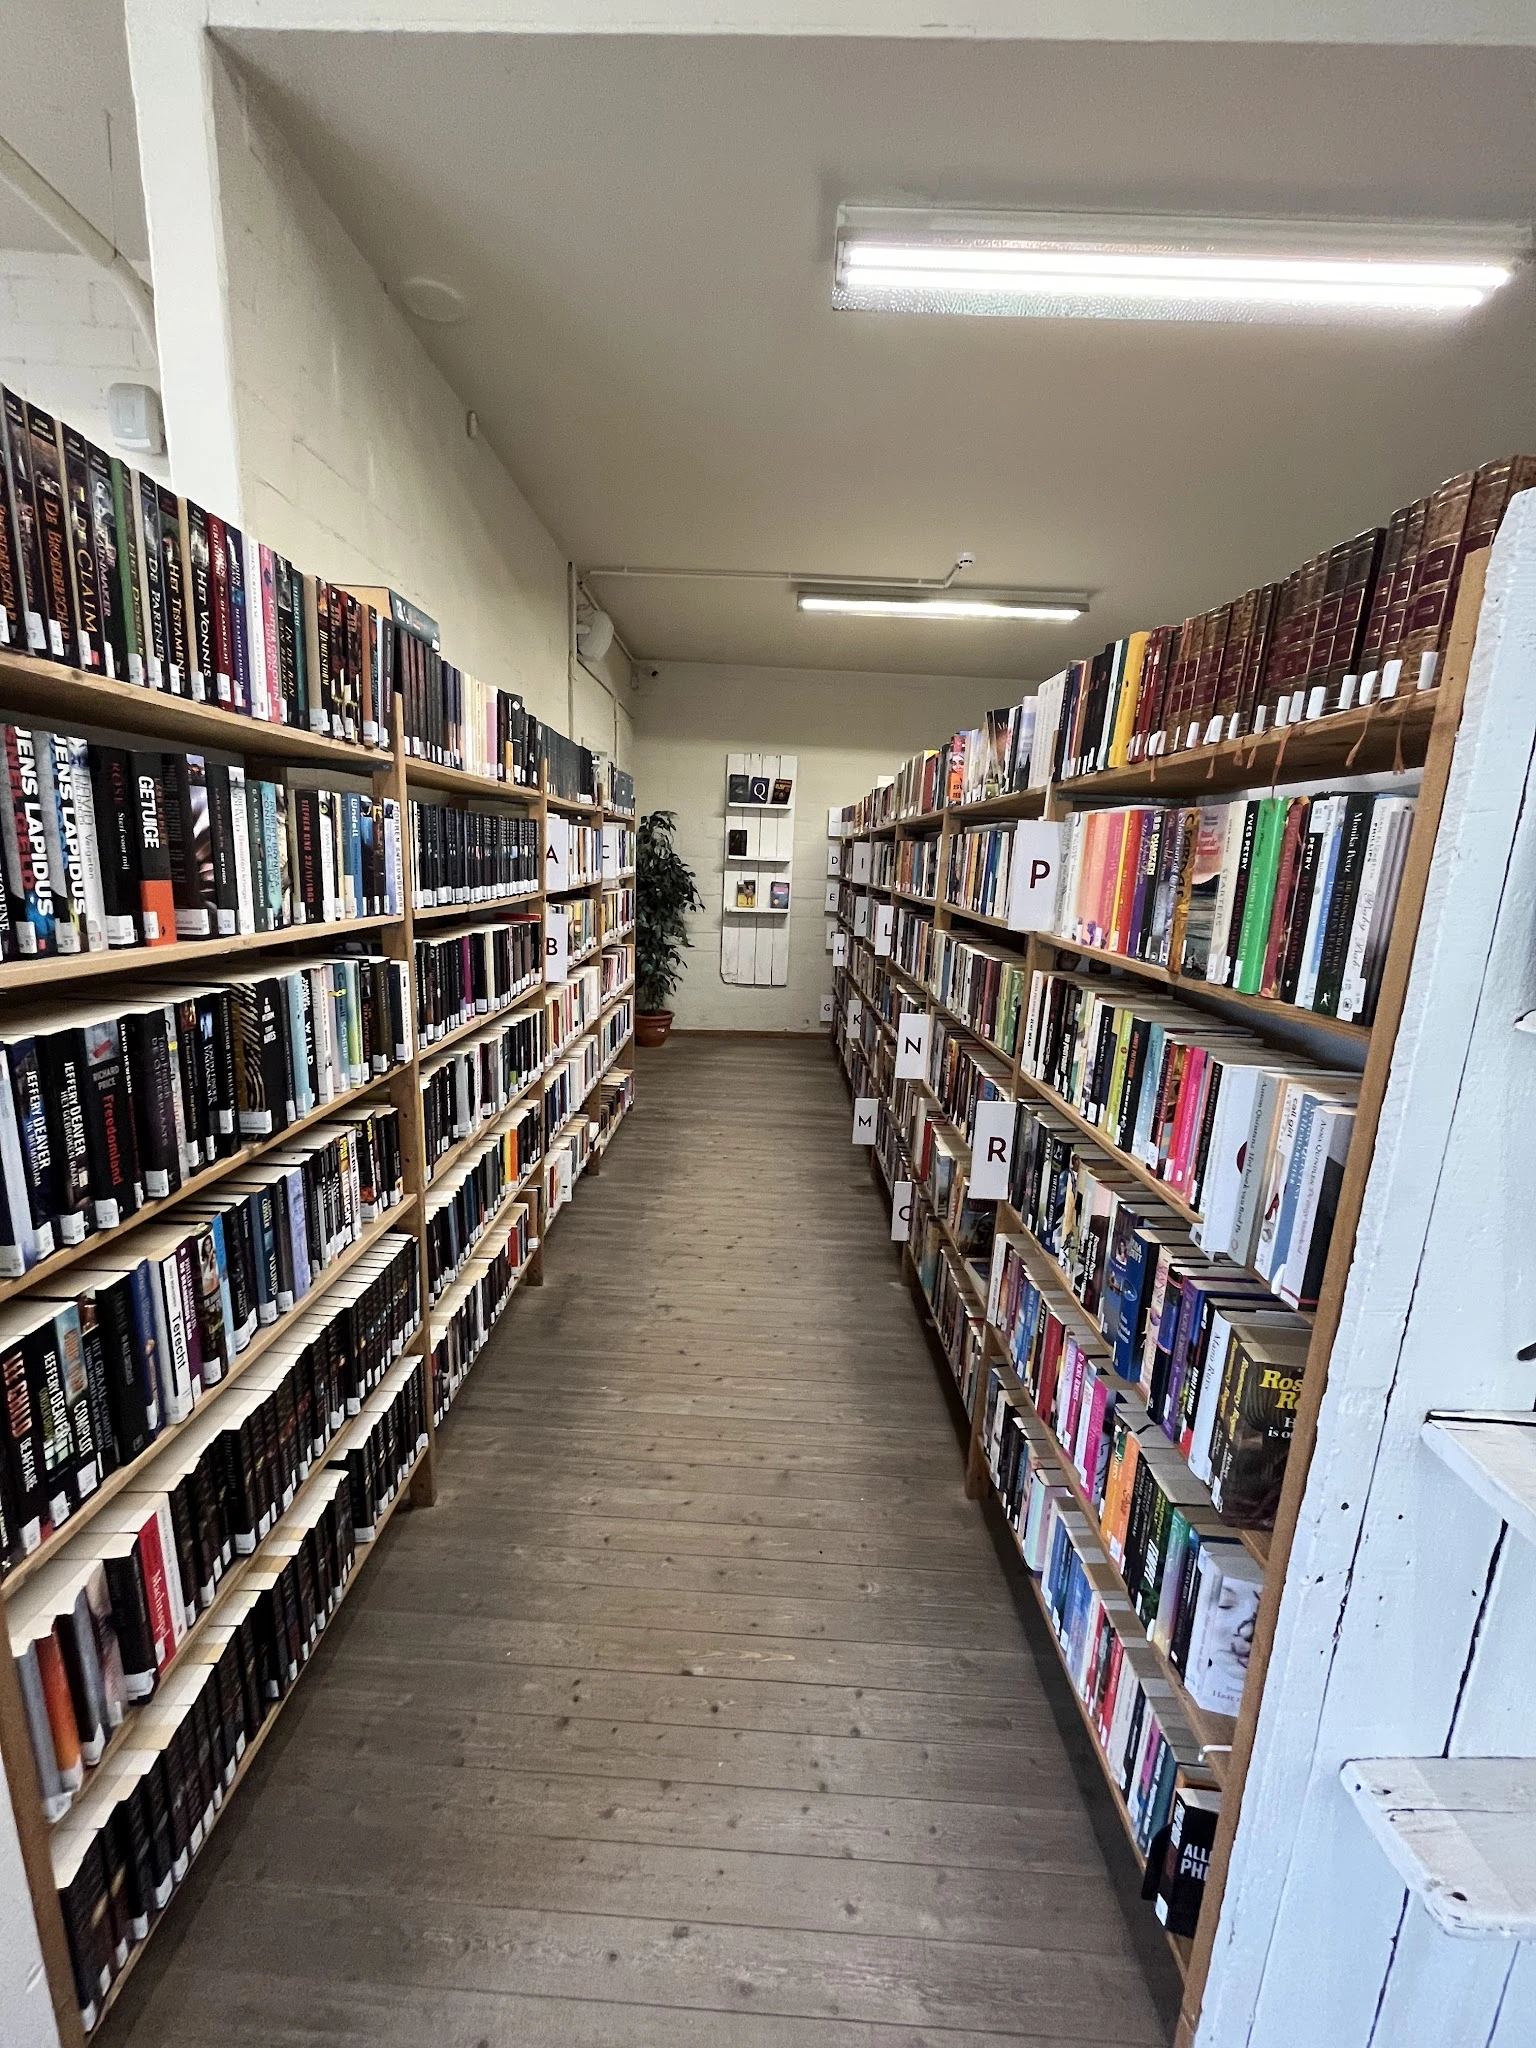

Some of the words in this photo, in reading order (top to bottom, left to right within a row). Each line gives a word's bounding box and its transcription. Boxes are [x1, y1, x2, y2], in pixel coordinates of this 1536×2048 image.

[49, 530, 70, 640] BROEDERSCHAP
[148, 557, 158, 583] DE
[168, 562, 180, 593] HET
[197, 568, 207, 604] HET
[76, 549, 98, 633] CLAIM
[151, 590, 165, 662] PARTNER
[171, 598, 186, 680] TESTAMENT
[200, 611, 212, 678] VONNIS
[270, 643, 279, 702] GESLOTEN
[15, 727, 38, 796] JENS
[54, 733, 72, 801] JENS
[754, 782, 766, 801] Q
[117, 812, 125, 836] Sterf
[138, 775, 159, 849] GETUIGE
[302, 799, 310, 832] STEPHEN
[1245, 813, 1255, 838] YVES
[1350, 812, 1363, 847] Monika
[24, 802, 54, 916] LAPIDUS
[84, 834, 94, 880] Vergeten
[120, 834, 128, 853] voor
[304, 832, 312, 852] KING
[546, 844, 559, 864] A
[1240, 839, 1251, 870] PETRY
[1304, 837, 1315, 871] PETRY
[1367, 822, 1378, 863] PHILLIPS
[61, 806, 86, 915] LAPIDUS
[122, 854, 130, 870] mij
[831, 856, 839, 865] D
[1029, 859, 1051, 889] P
[829, 893, 835, 901] E
[1215, 868, 1228, 926] STARTERS
[1359, 890, 1375, 931] Baby
[860, 910, 867, 924] J
[884, 923, 892, 937] L
[547, 937, 558, 956] B
[837, 945, 845, 955] H
[824, 1003, 831, 1012] G
[853, 1014, 861, 1025] K
[120, 1023, 128, 1053] DAVID
[305, 1020, 314, 1066] WILD
[905, 1036, 922, 1055] N
[63, 1061, 79, 1106] JEFFERY
[123, 1055, 133, 1095] HEWSON
[26, 1070, 41, 1116] JEFFERY
[1290, 1097, 1298, 1117] call
[62, 1111, 75, 1160] GEBROKEN
[70, 1105, 86, 1157] DEAVER
[858, 1115, 872, 1127] M
[1286, 1118, 1295, 1139] girl
[1318, 1119, 1328, 1141] ANNA
[33, 1116, 50, 1170] DEAVER
[103, 1094, 124, 1186] Freedomland
[987, 1136, 1007, 1163] R
[1247, 1152, 1256, 1168] Het
[1309, 1142, 1323, 1186] QUINDLEN
[171, 1311, 186, 1370] Terecht
[3, 1351, 25, 1386] LEE
[44, 1350, 60, 1394] JEFFERY
[8, 1380, 33, 1439] CHILD
[50, 1390, 71, 1441] DEAVER
[20, 1436, 32, 1449] DE
[73, 1399, 93, 1458] COMPLOT
[1268, 1426, 1279, 1438] is
[21, 1448, 38, 1493] AFFAIRE
